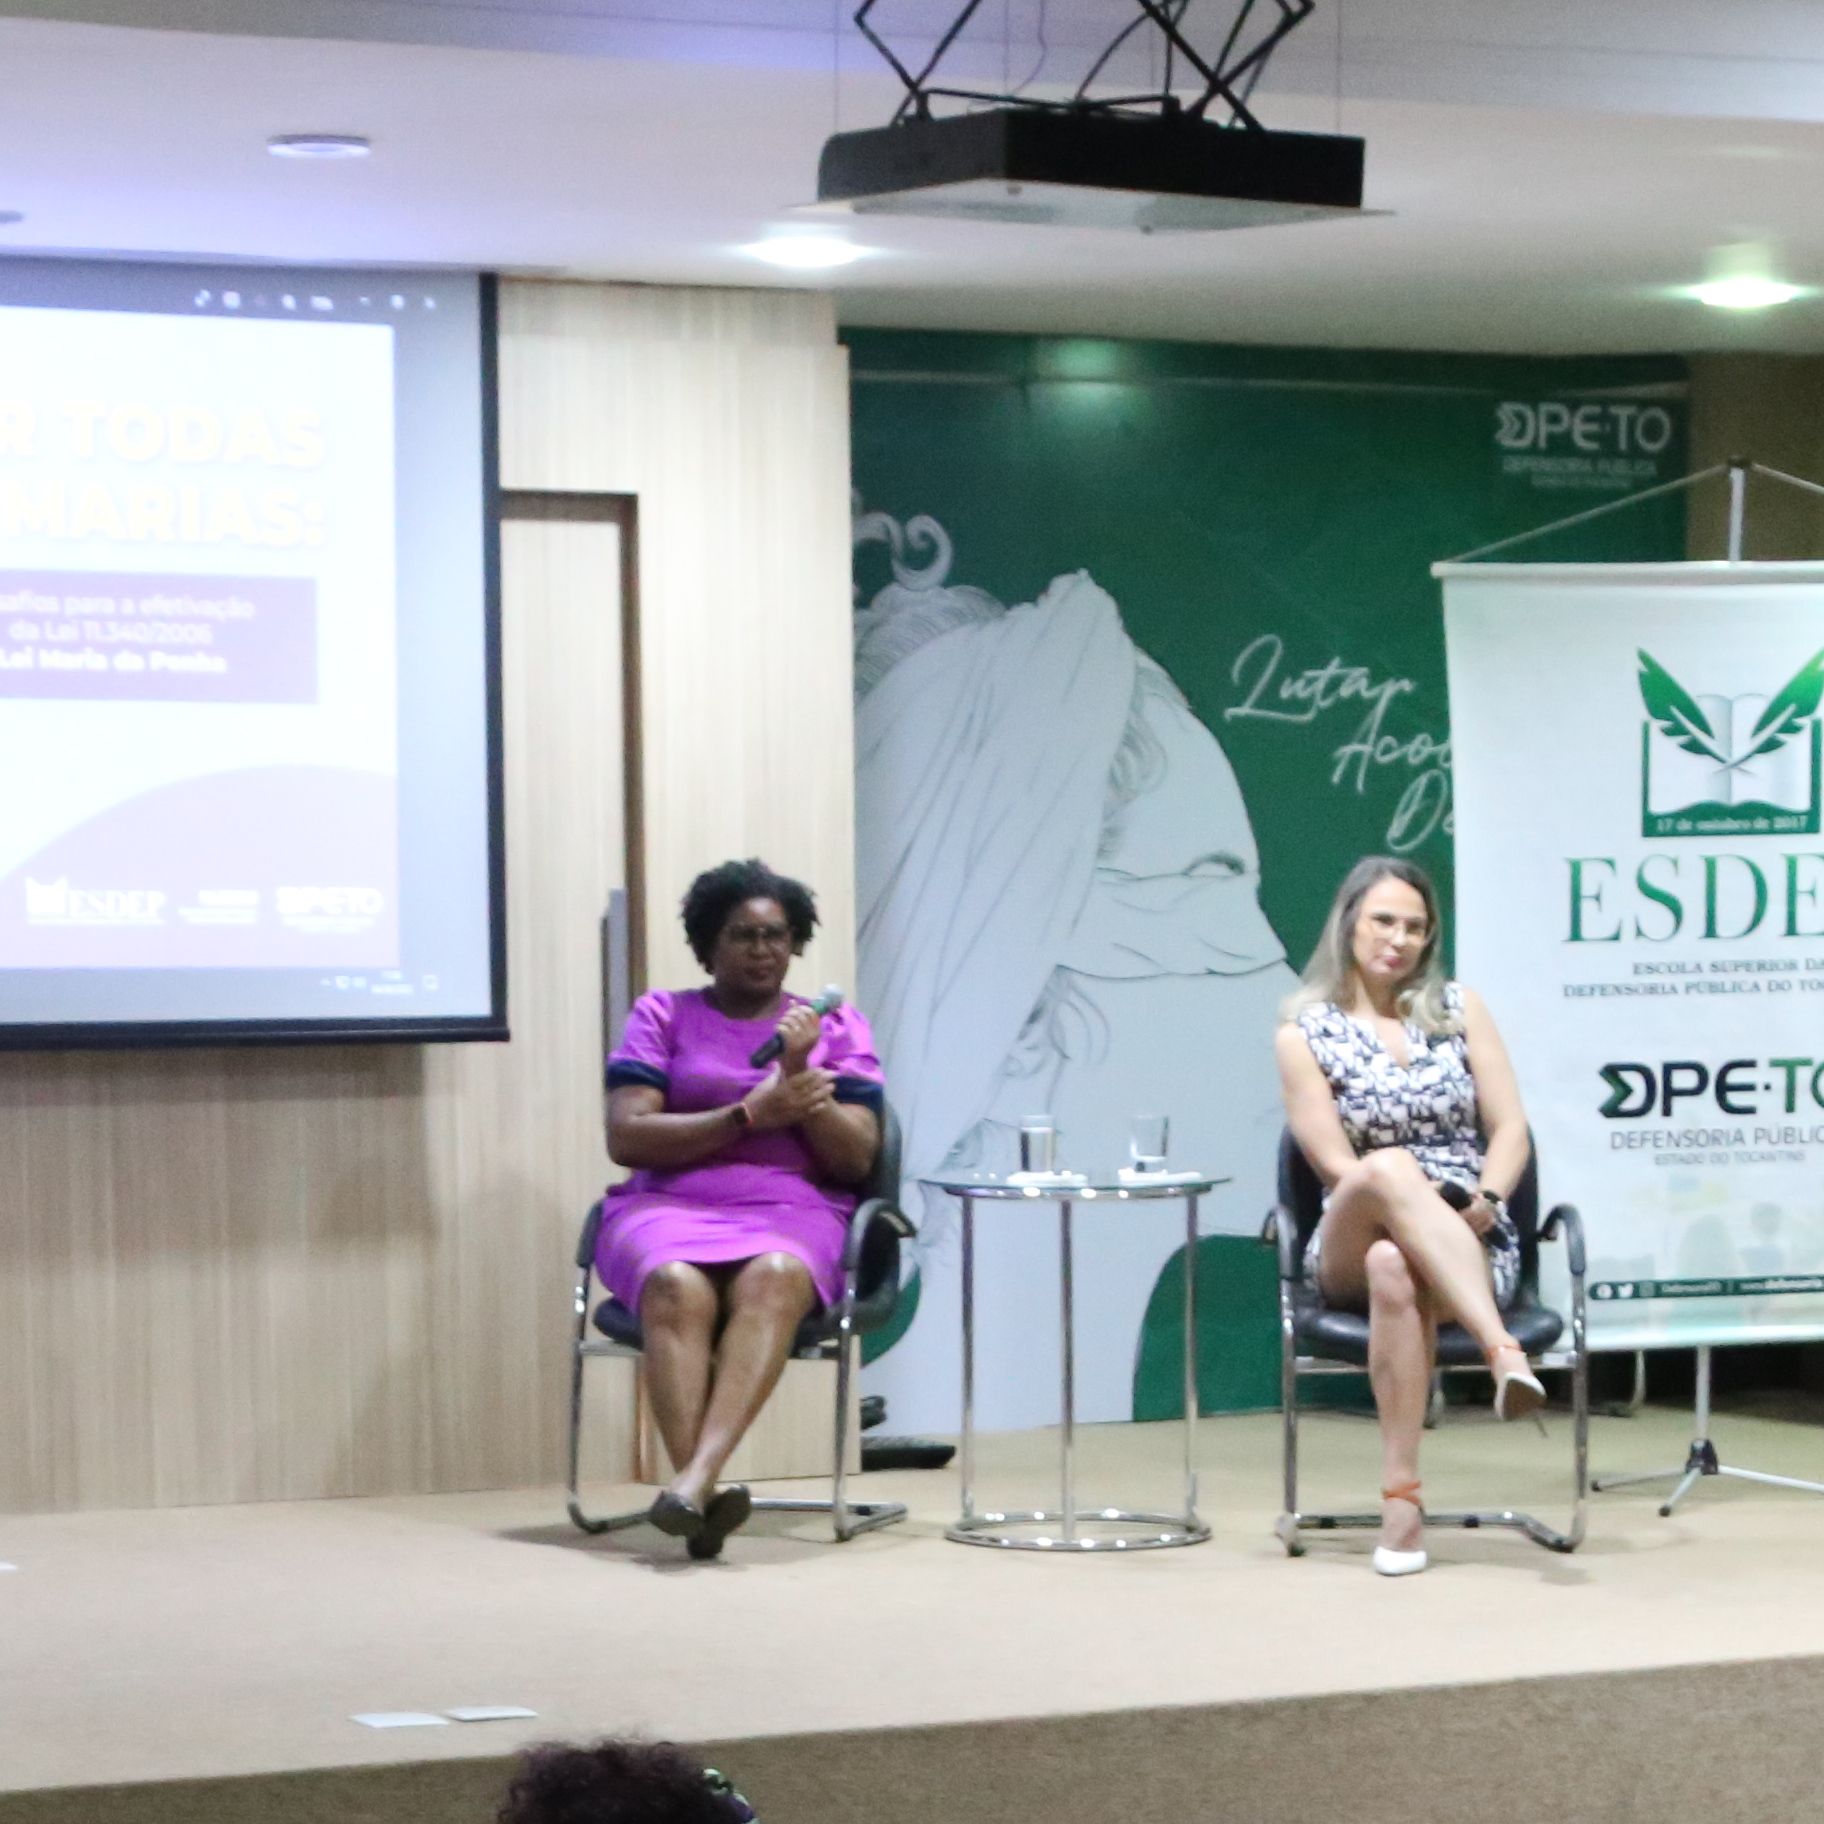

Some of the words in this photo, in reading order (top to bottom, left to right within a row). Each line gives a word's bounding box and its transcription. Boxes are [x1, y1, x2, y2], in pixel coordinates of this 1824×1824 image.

[62, 398, 324, 470] TODAS
[0, 477, 324, 550] MARIAS:
[63, 595, 117, 617] para
[120, 596, 136, 615] a
[8, 619, 40, 641] da
[44, 620, 80, 642] Lei
[38, 647, 108, 672] Maria
[112, 650, 146, 672] da
[150, 650, 227, 674] Penha
[1222, 633, 1416, 723] Lutar
[1631, 960, 1704, 976] ESCOLA
[1709, 958, 1799, 974] SUPERIOR
[1561, 982, 1678, 998] DEFENSORIA
[1767, 978, 1792, 993] DO
[1610, 1127, 1746, 1151] DEFENSORIA
